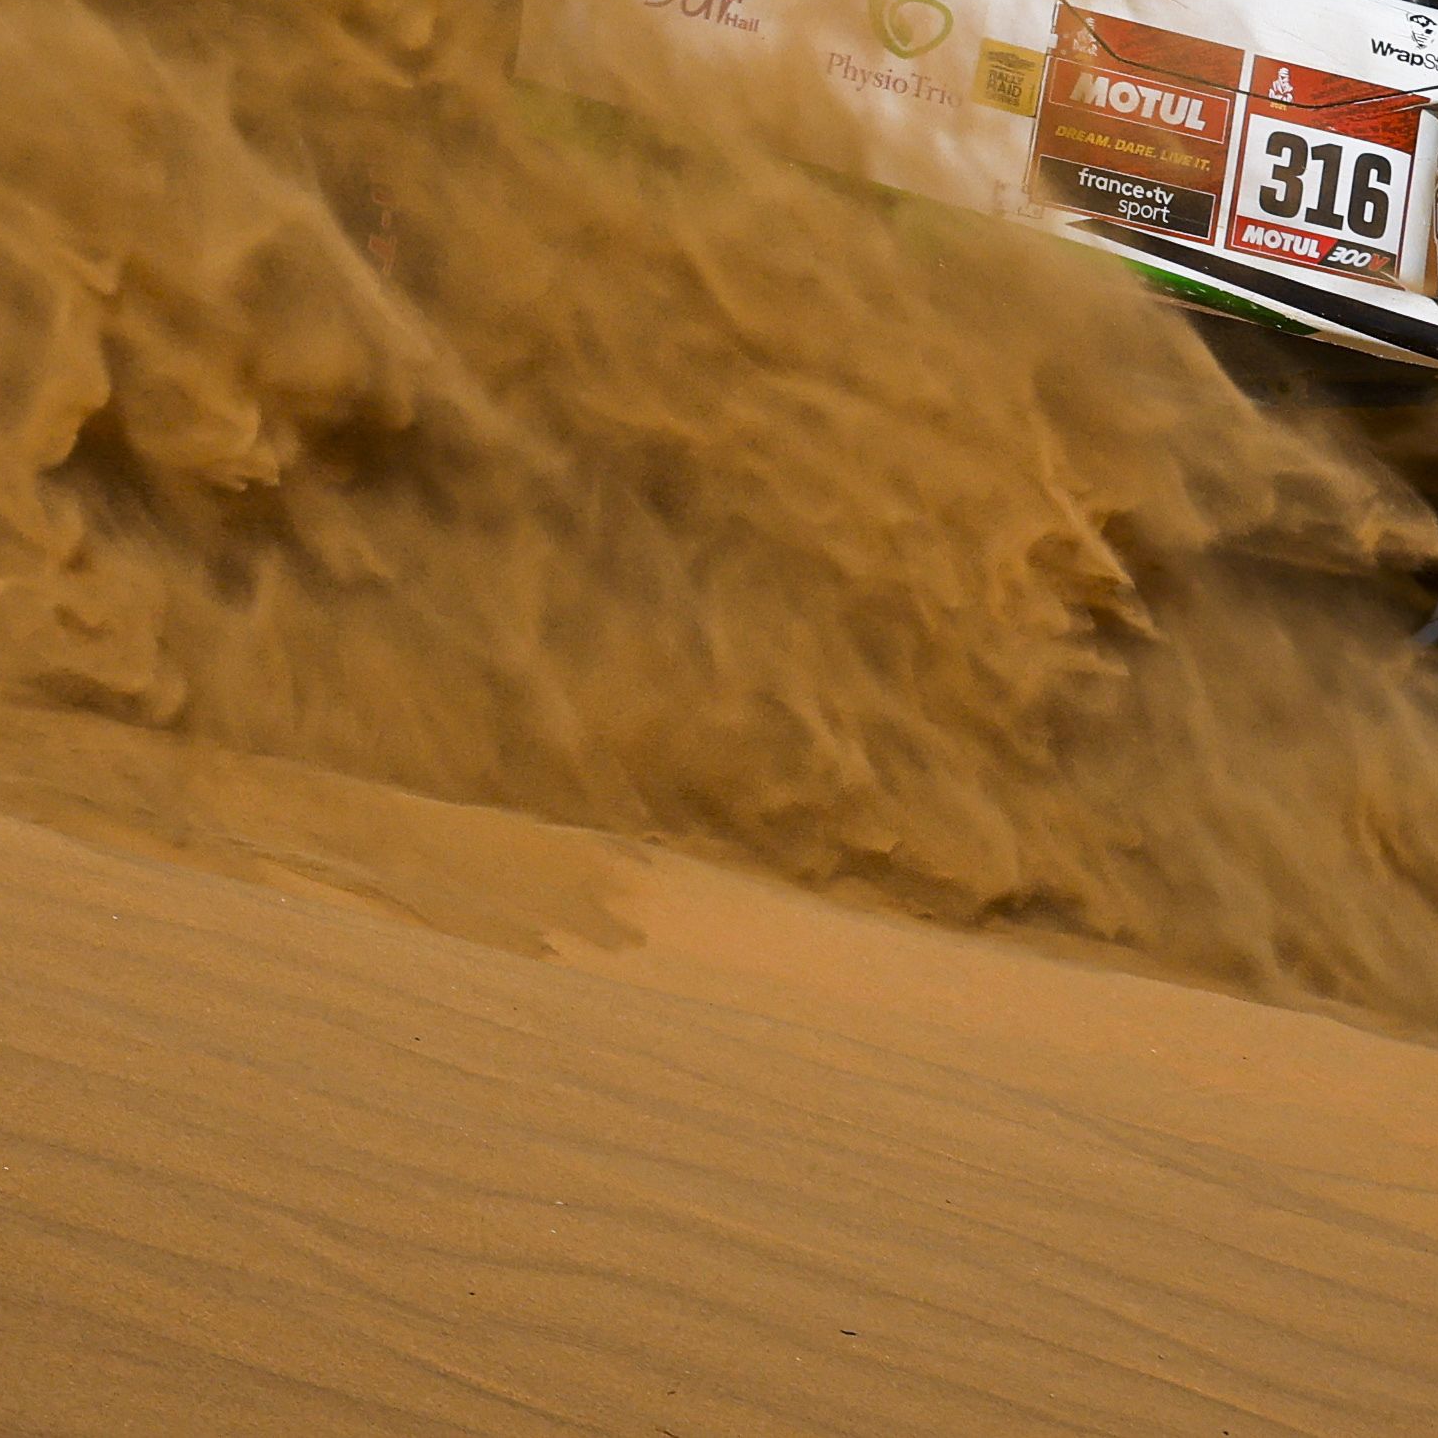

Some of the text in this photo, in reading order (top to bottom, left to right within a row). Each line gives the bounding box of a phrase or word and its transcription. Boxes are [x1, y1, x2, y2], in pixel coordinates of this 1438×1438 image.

[724, 12, 761, 32] Hail
[1069, 72, 1207, 131] MOTUL
[1114, 139, 1156, 159] DARE.
[1258, 131, 1392, 240] 316
[1118, 199, 1170, 224] sport
[1241, 224, 1390, 272] MOTUL 300V
